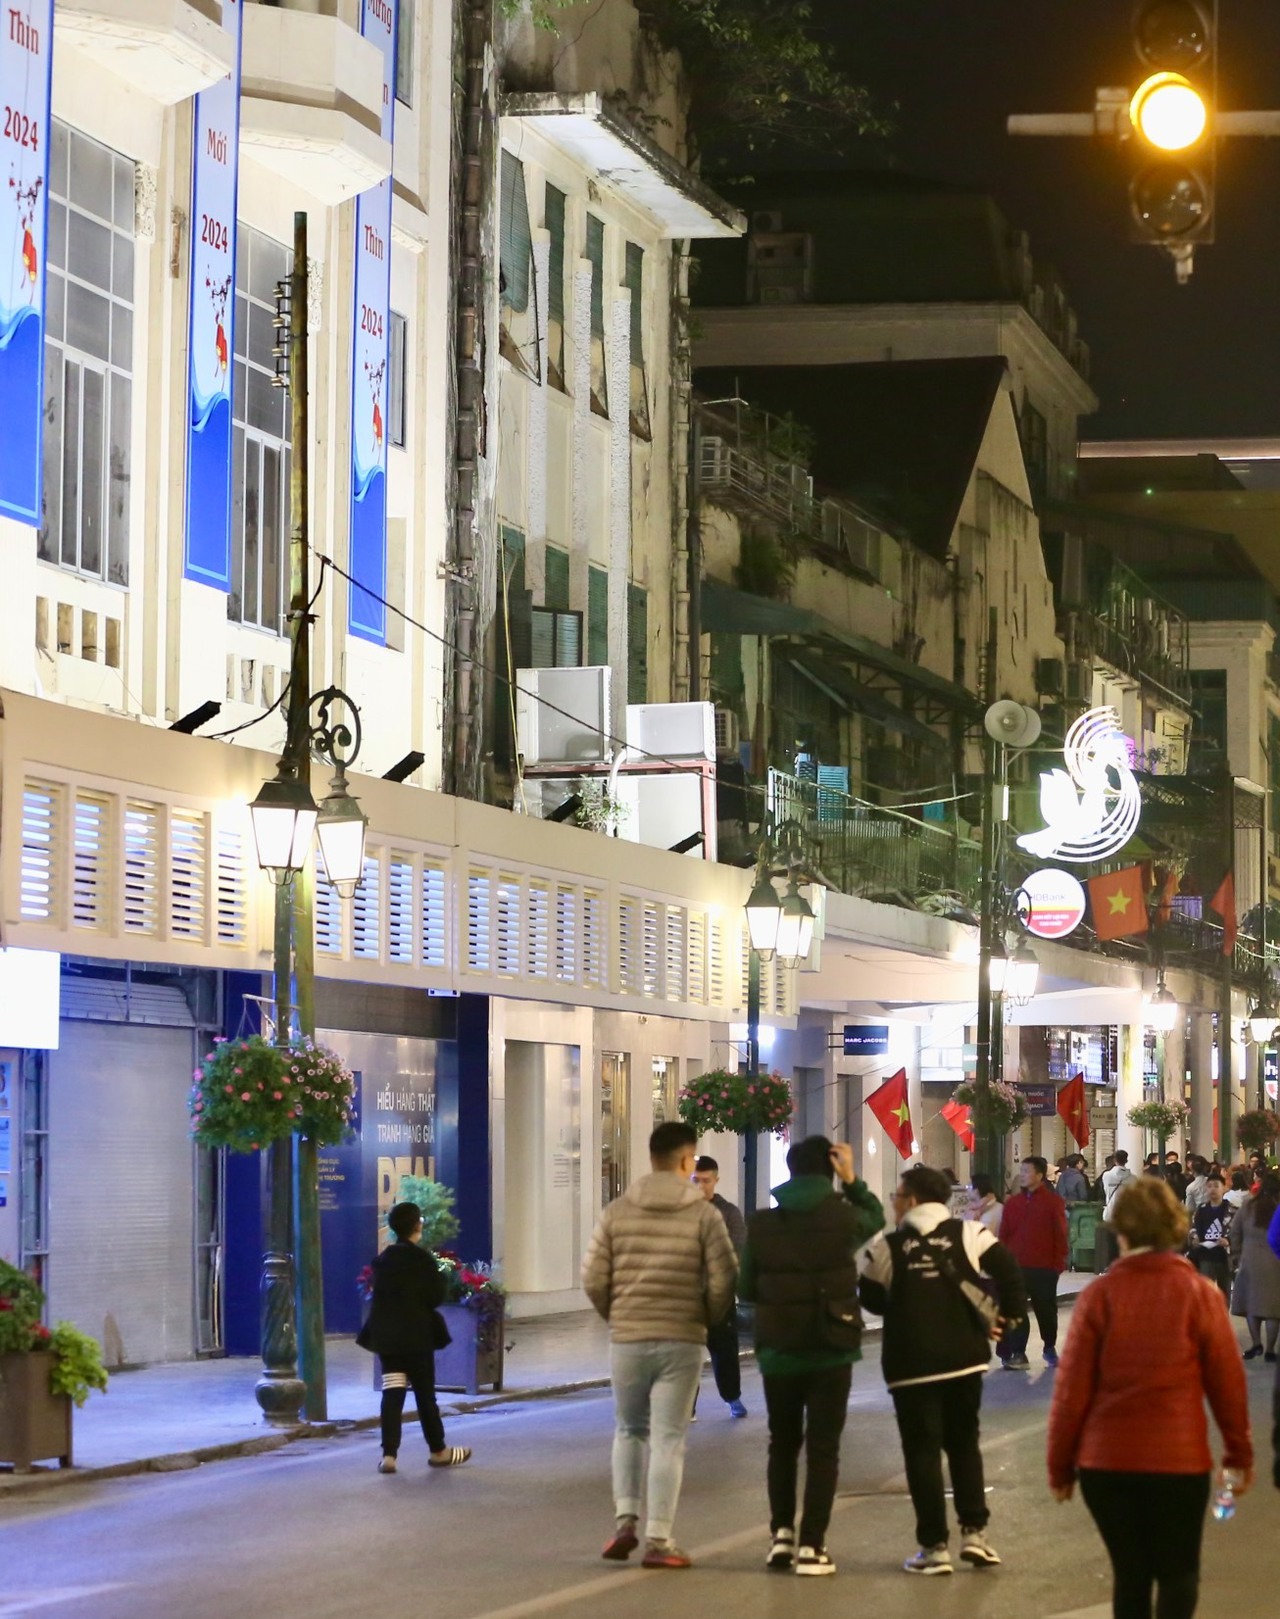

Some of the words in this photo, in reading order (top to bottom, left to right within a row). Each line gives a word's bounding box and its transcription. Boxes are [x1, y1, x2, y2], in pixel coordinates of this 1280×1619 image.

[8, 9, 39, 55] Thìn
[4, 105, 38, 152] 2024
[207, 128, 227, 165] Mới
[202, 214, 228, 253] 2024
[364, 224, 384, 260] Thìn
[361, 304, 383, 340] 2024
[377, 1083, 394, 1111] HIỂU
[396, 1087, 415, 1112] HÀNG
[377, 1120, 401, 1143] TRÁNH
